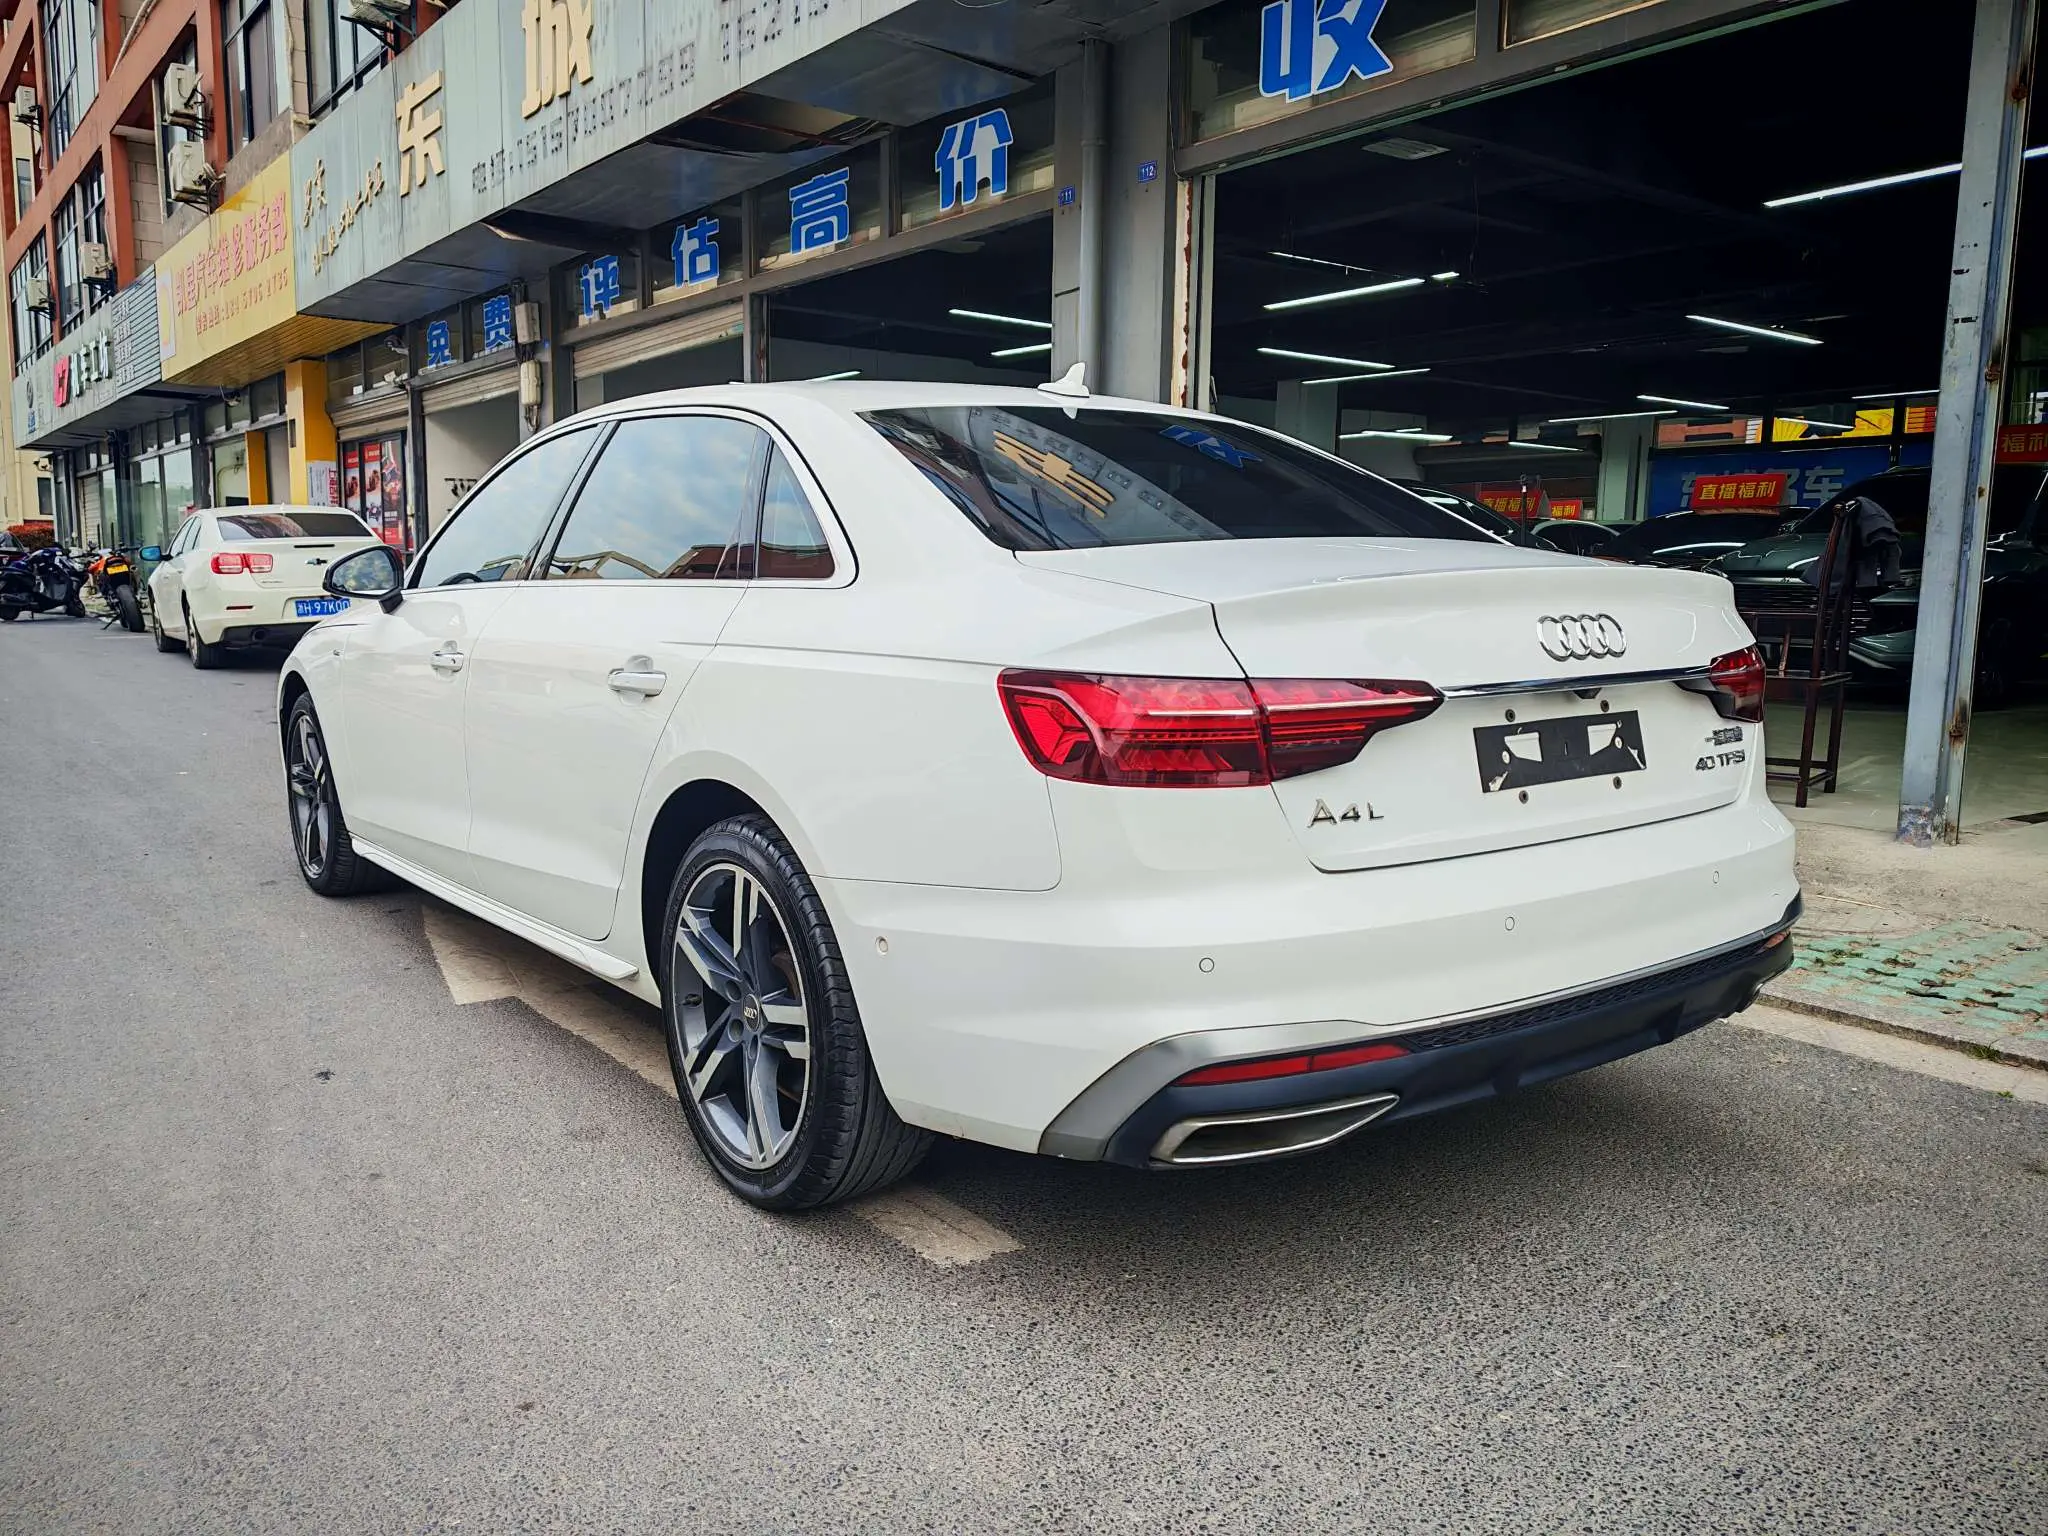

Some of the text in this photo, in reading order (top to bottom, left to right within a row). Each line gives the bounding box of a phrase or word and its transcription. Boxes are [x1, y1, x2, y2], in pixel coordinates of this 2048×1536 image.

[426, 294, 512, 369] 免费
[1699, 480, 1777, 502] 直播福利
[1695, 755, 1716, 771] 40
[1306, 798, 1385, 829] A4L
